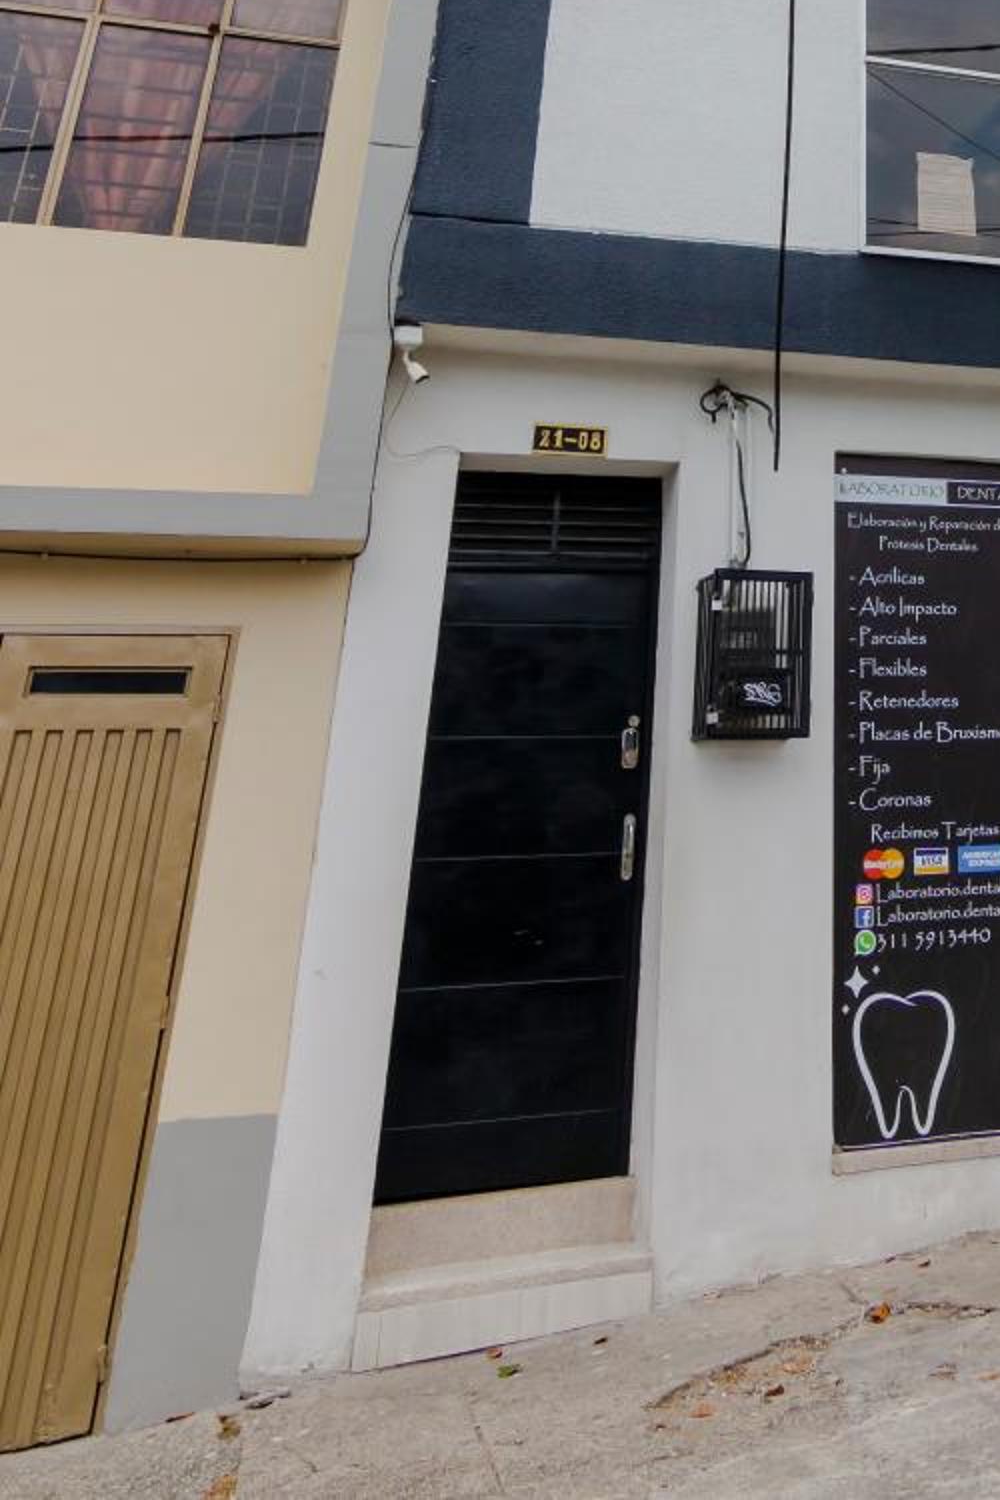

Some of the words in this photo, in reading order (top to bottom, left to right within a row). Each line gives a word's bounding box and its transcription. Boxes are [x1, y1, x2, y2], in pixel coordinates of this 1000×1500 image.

[539, 429, 601, 451] 21-08
[859, 596, 896, 617] Alto
[899, 596, 957, 623] Impacto
[859, 625, 927, 647] Parciales
[859, 657, 927, 679] Flexibles
[859, 689, 959, 711] Retenedores
[859, 721, 910, 744] Placas
[913, 721, 932, 740] de
[859, 755, 891, 785] Fija
[859, 787, 932, 811] Coronas
[871, 822, 939, 843] Recibimos
[941, 821, 1000, 844] Tarjetas
